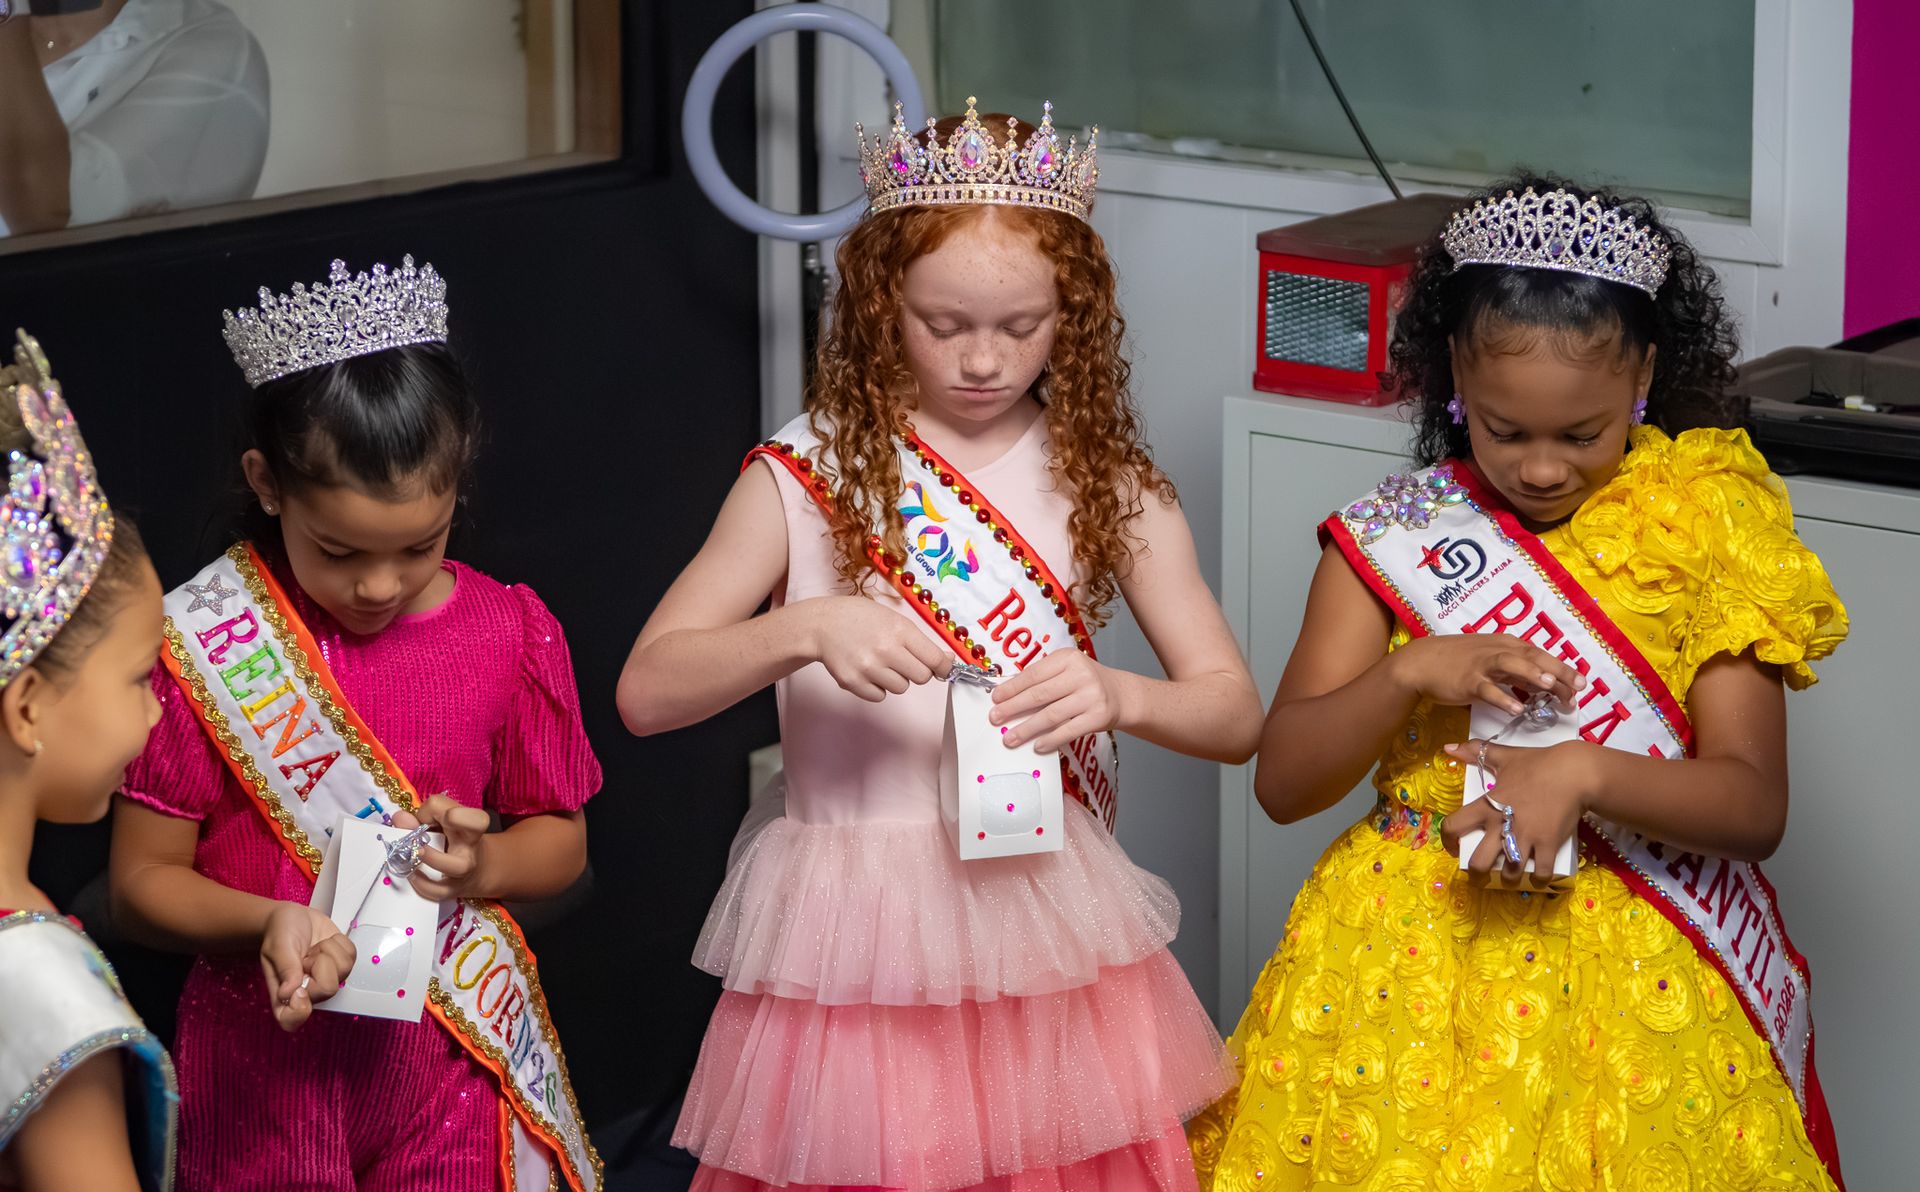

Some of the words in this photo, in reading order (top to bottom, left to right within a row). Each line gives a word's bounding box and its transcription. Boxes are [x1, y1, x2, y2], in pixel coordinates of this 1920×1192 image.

[915, 552, 936, 577] Group
[1437, 601, 1460, 620] GUCCI
[1459, 576, 1490, 603] DANCERS
[1490, 558, 1513, 577] ARUBA
[976, 587, 1050, 672] Rei
[195, 606, 341, 802] REINA
[436, 899, 531, 1070] NOORD
